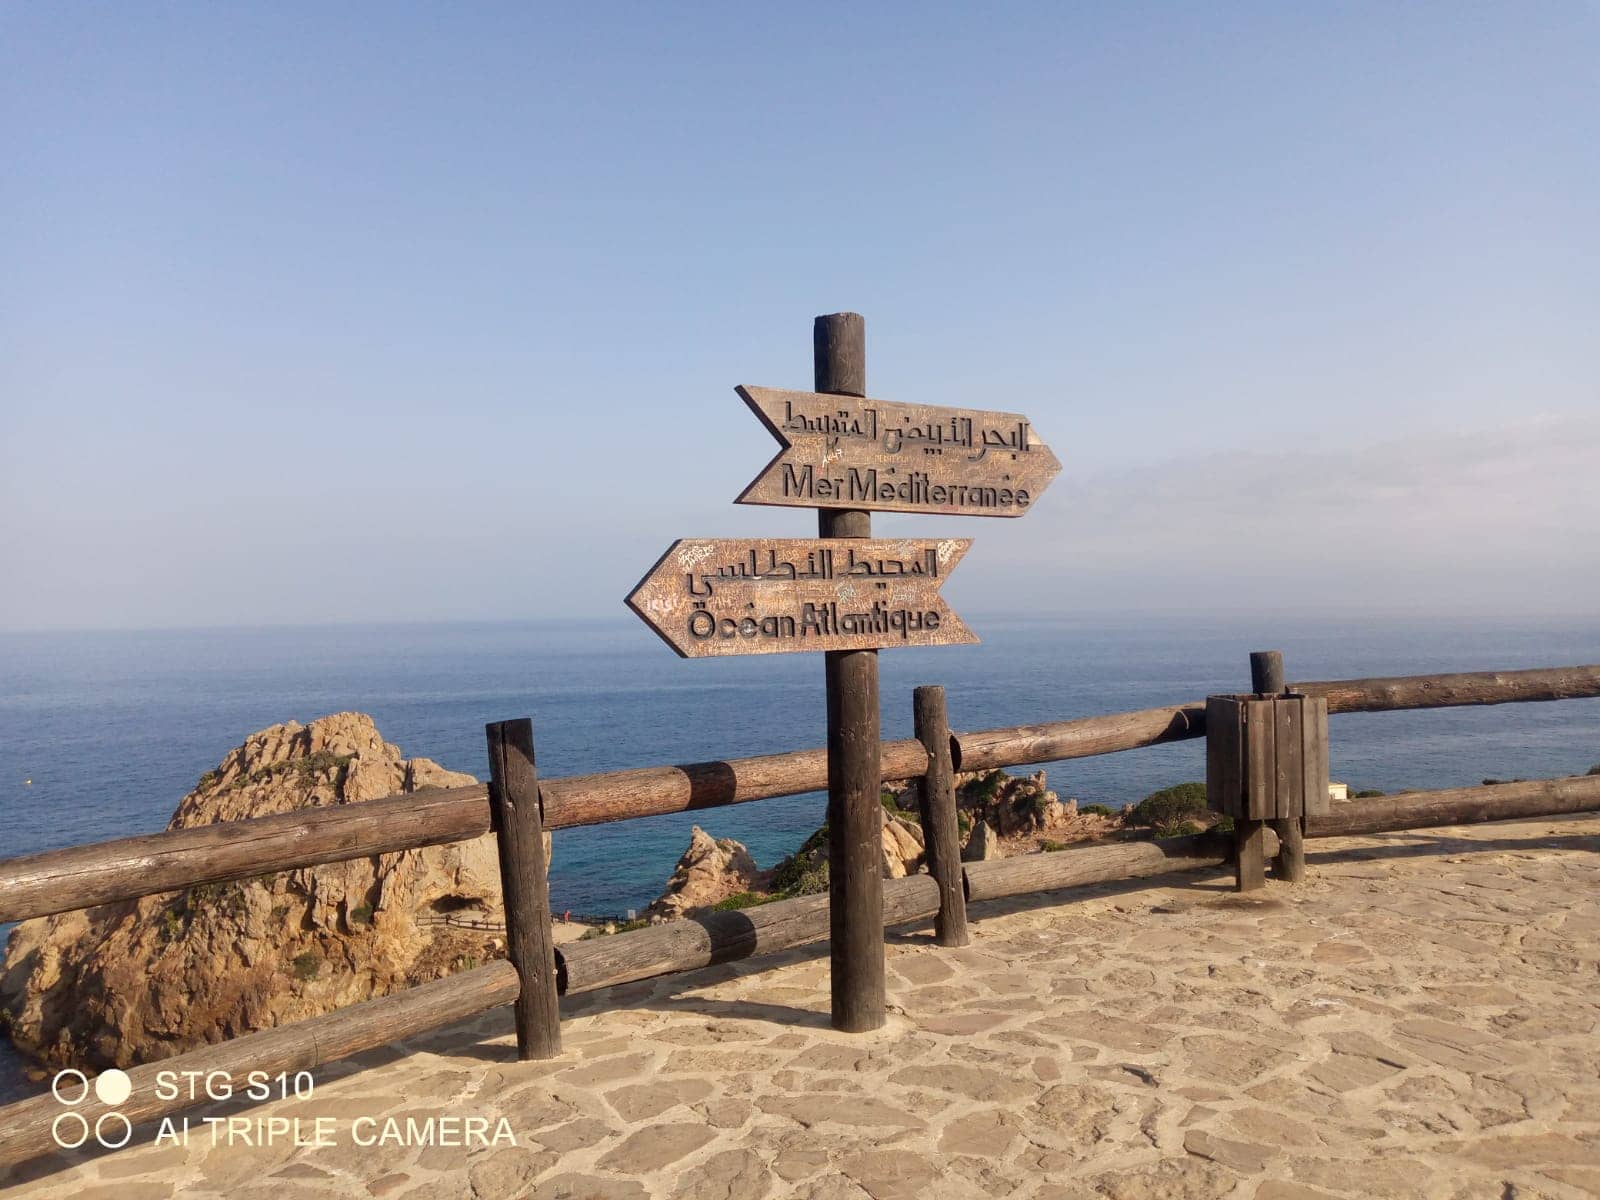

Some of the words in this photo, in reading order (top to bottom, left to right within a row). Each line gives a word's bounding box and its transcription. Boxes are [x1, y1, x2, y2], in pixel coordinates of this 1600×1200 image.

[782, 400, 877, 450] المتوسط
[884, 416, 972, 455] الأبيض
[967, 421, 1030, 461] البحر
[781, 463, 845, 499] Mer
[848, 466, 1030, 508] Méditerranée
[838, 549, 938, 590] المحيط
[687, 602, 796, 640] Océan
[800, 600, 941, 639] Atlantique
